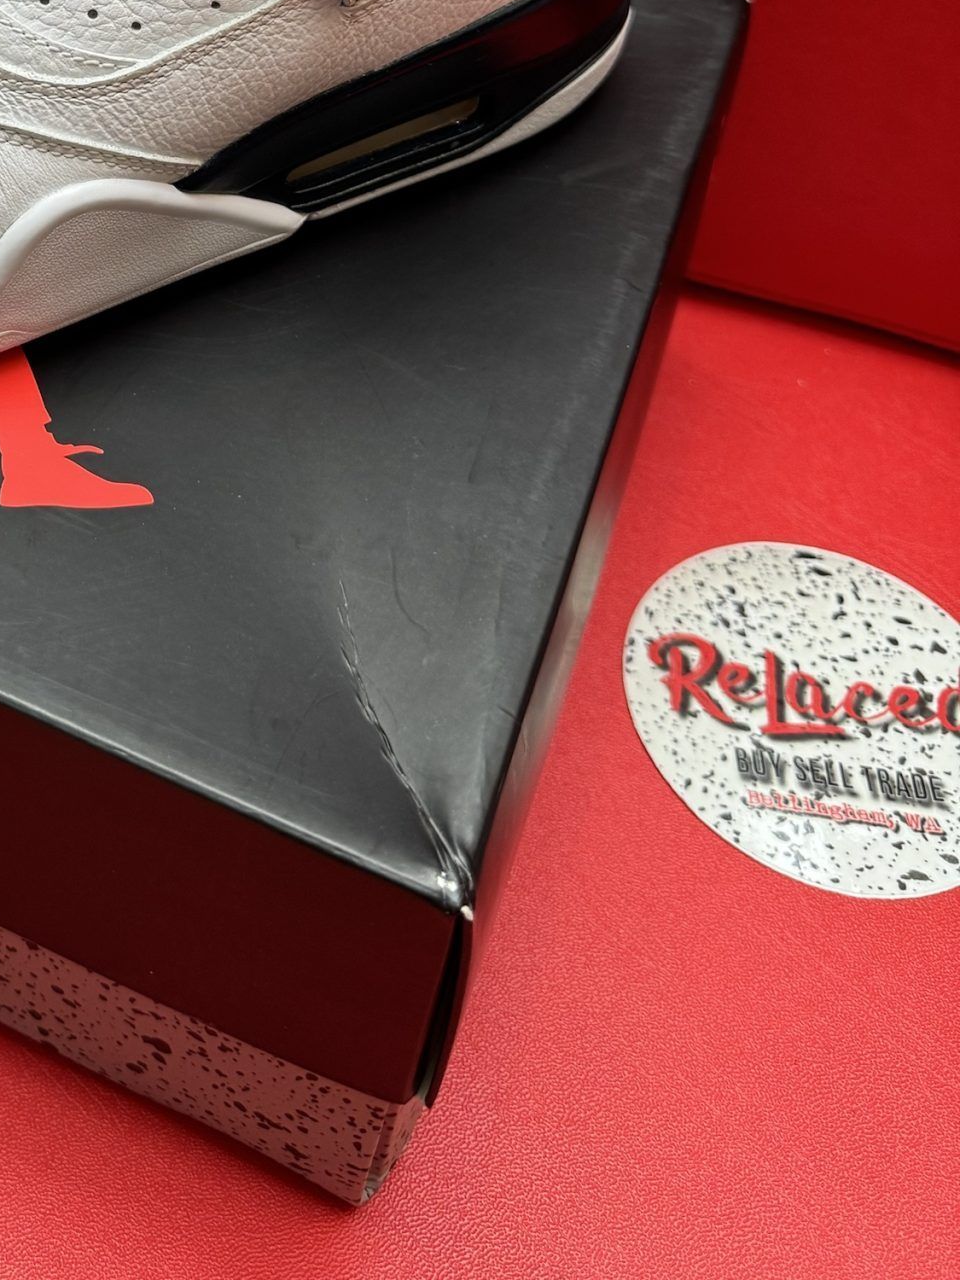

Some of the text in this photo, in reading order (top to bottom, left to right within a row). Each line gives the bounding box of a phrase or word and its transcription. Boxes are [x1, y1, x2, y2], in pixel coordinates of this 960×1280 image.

[734, 746, 945, 803] BUY SELL TRADE
[904, 811, 943, 833] WA
